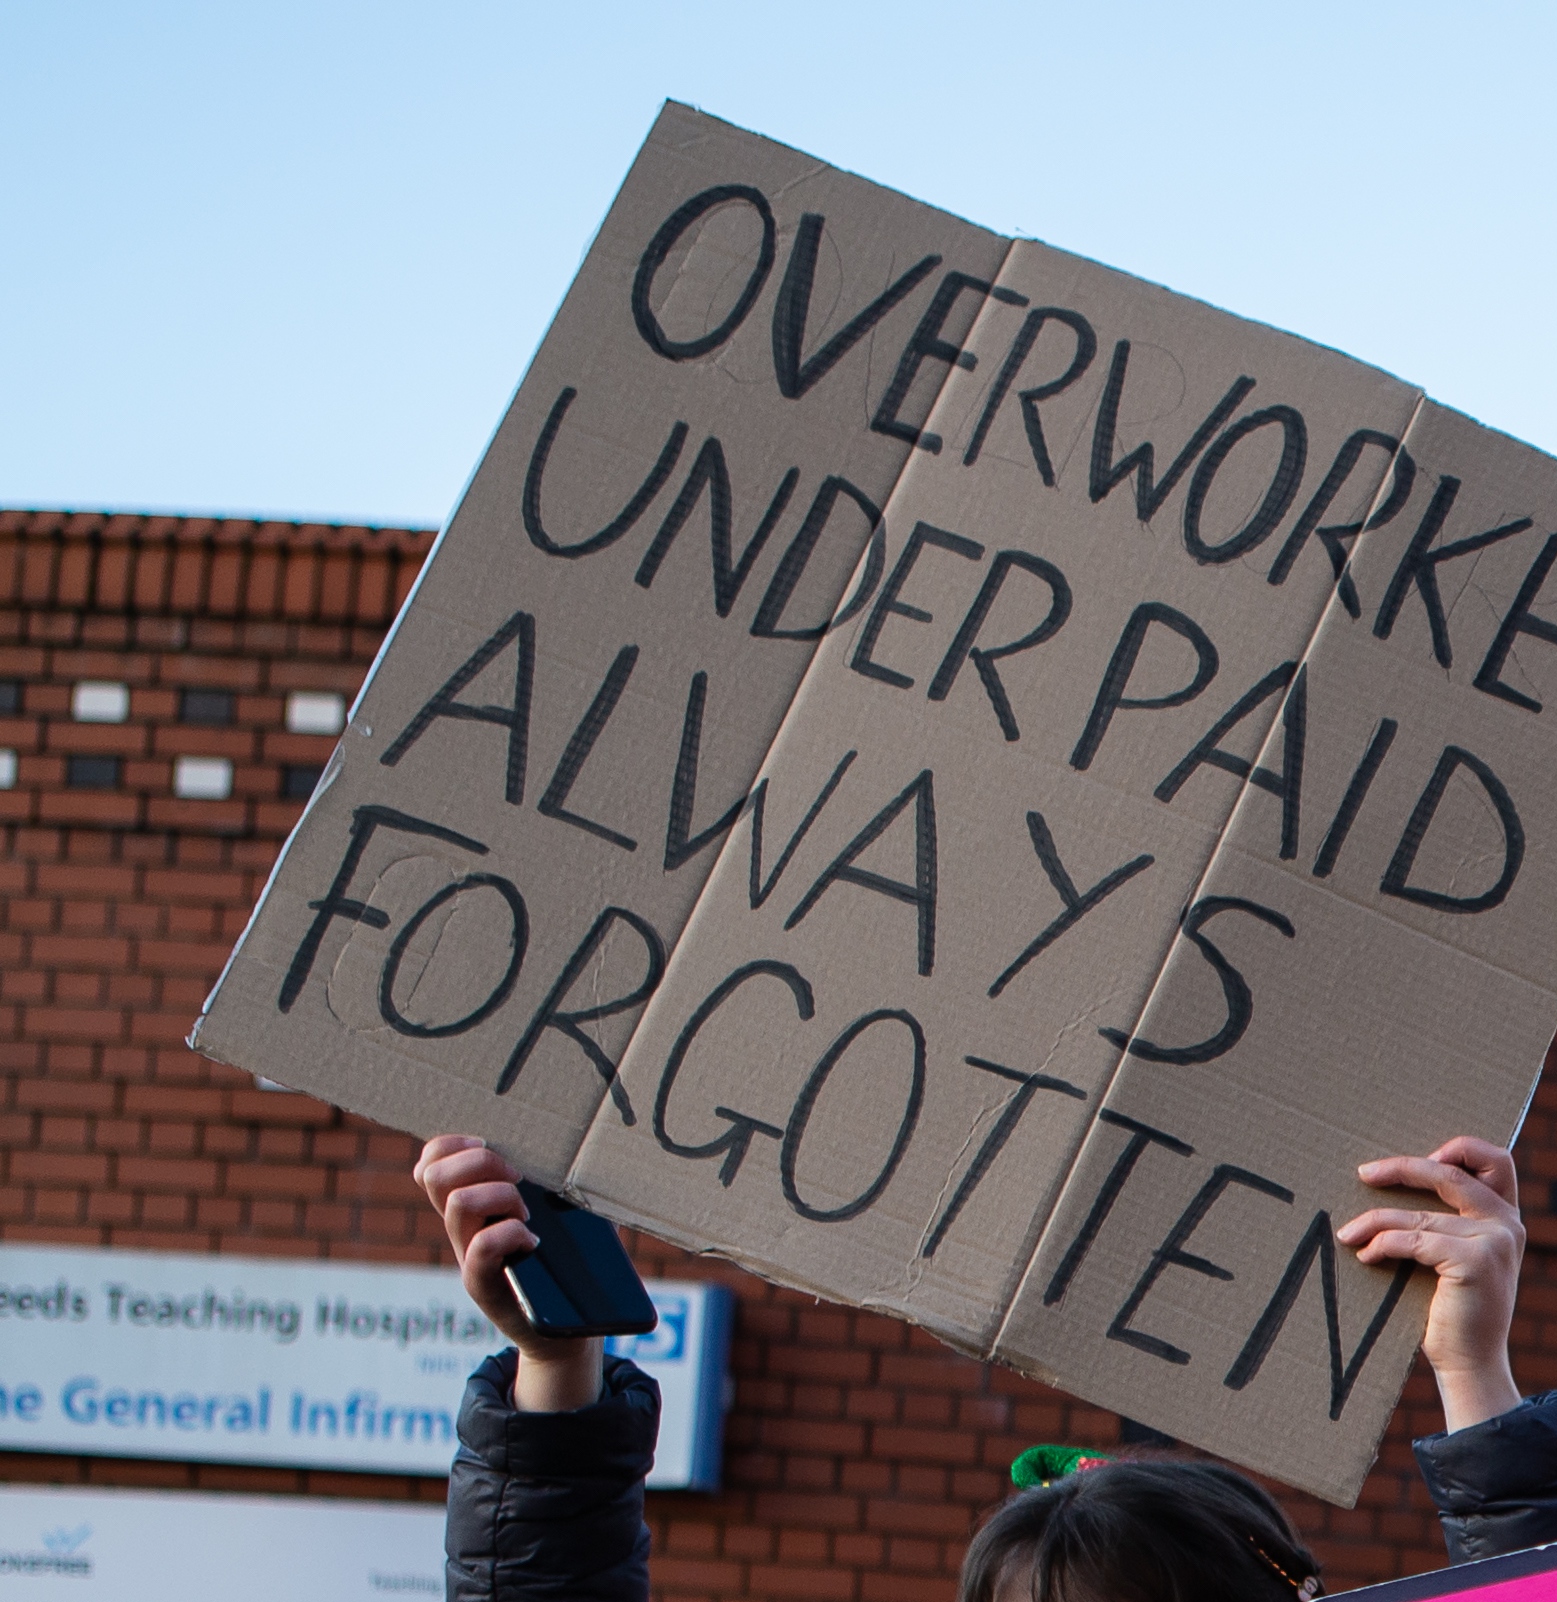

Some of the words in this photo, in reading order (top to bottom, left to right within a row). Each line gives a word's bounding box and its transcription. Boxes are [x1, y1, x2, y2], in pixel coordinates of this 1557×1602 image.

[380, 610, 1296, 1065] ALWAYS
[279, 804, 1416, 1421] FORGOTTEN
[62, 1377, 272, 1433] General
[107, 1283, 301, 1344] Teaching
